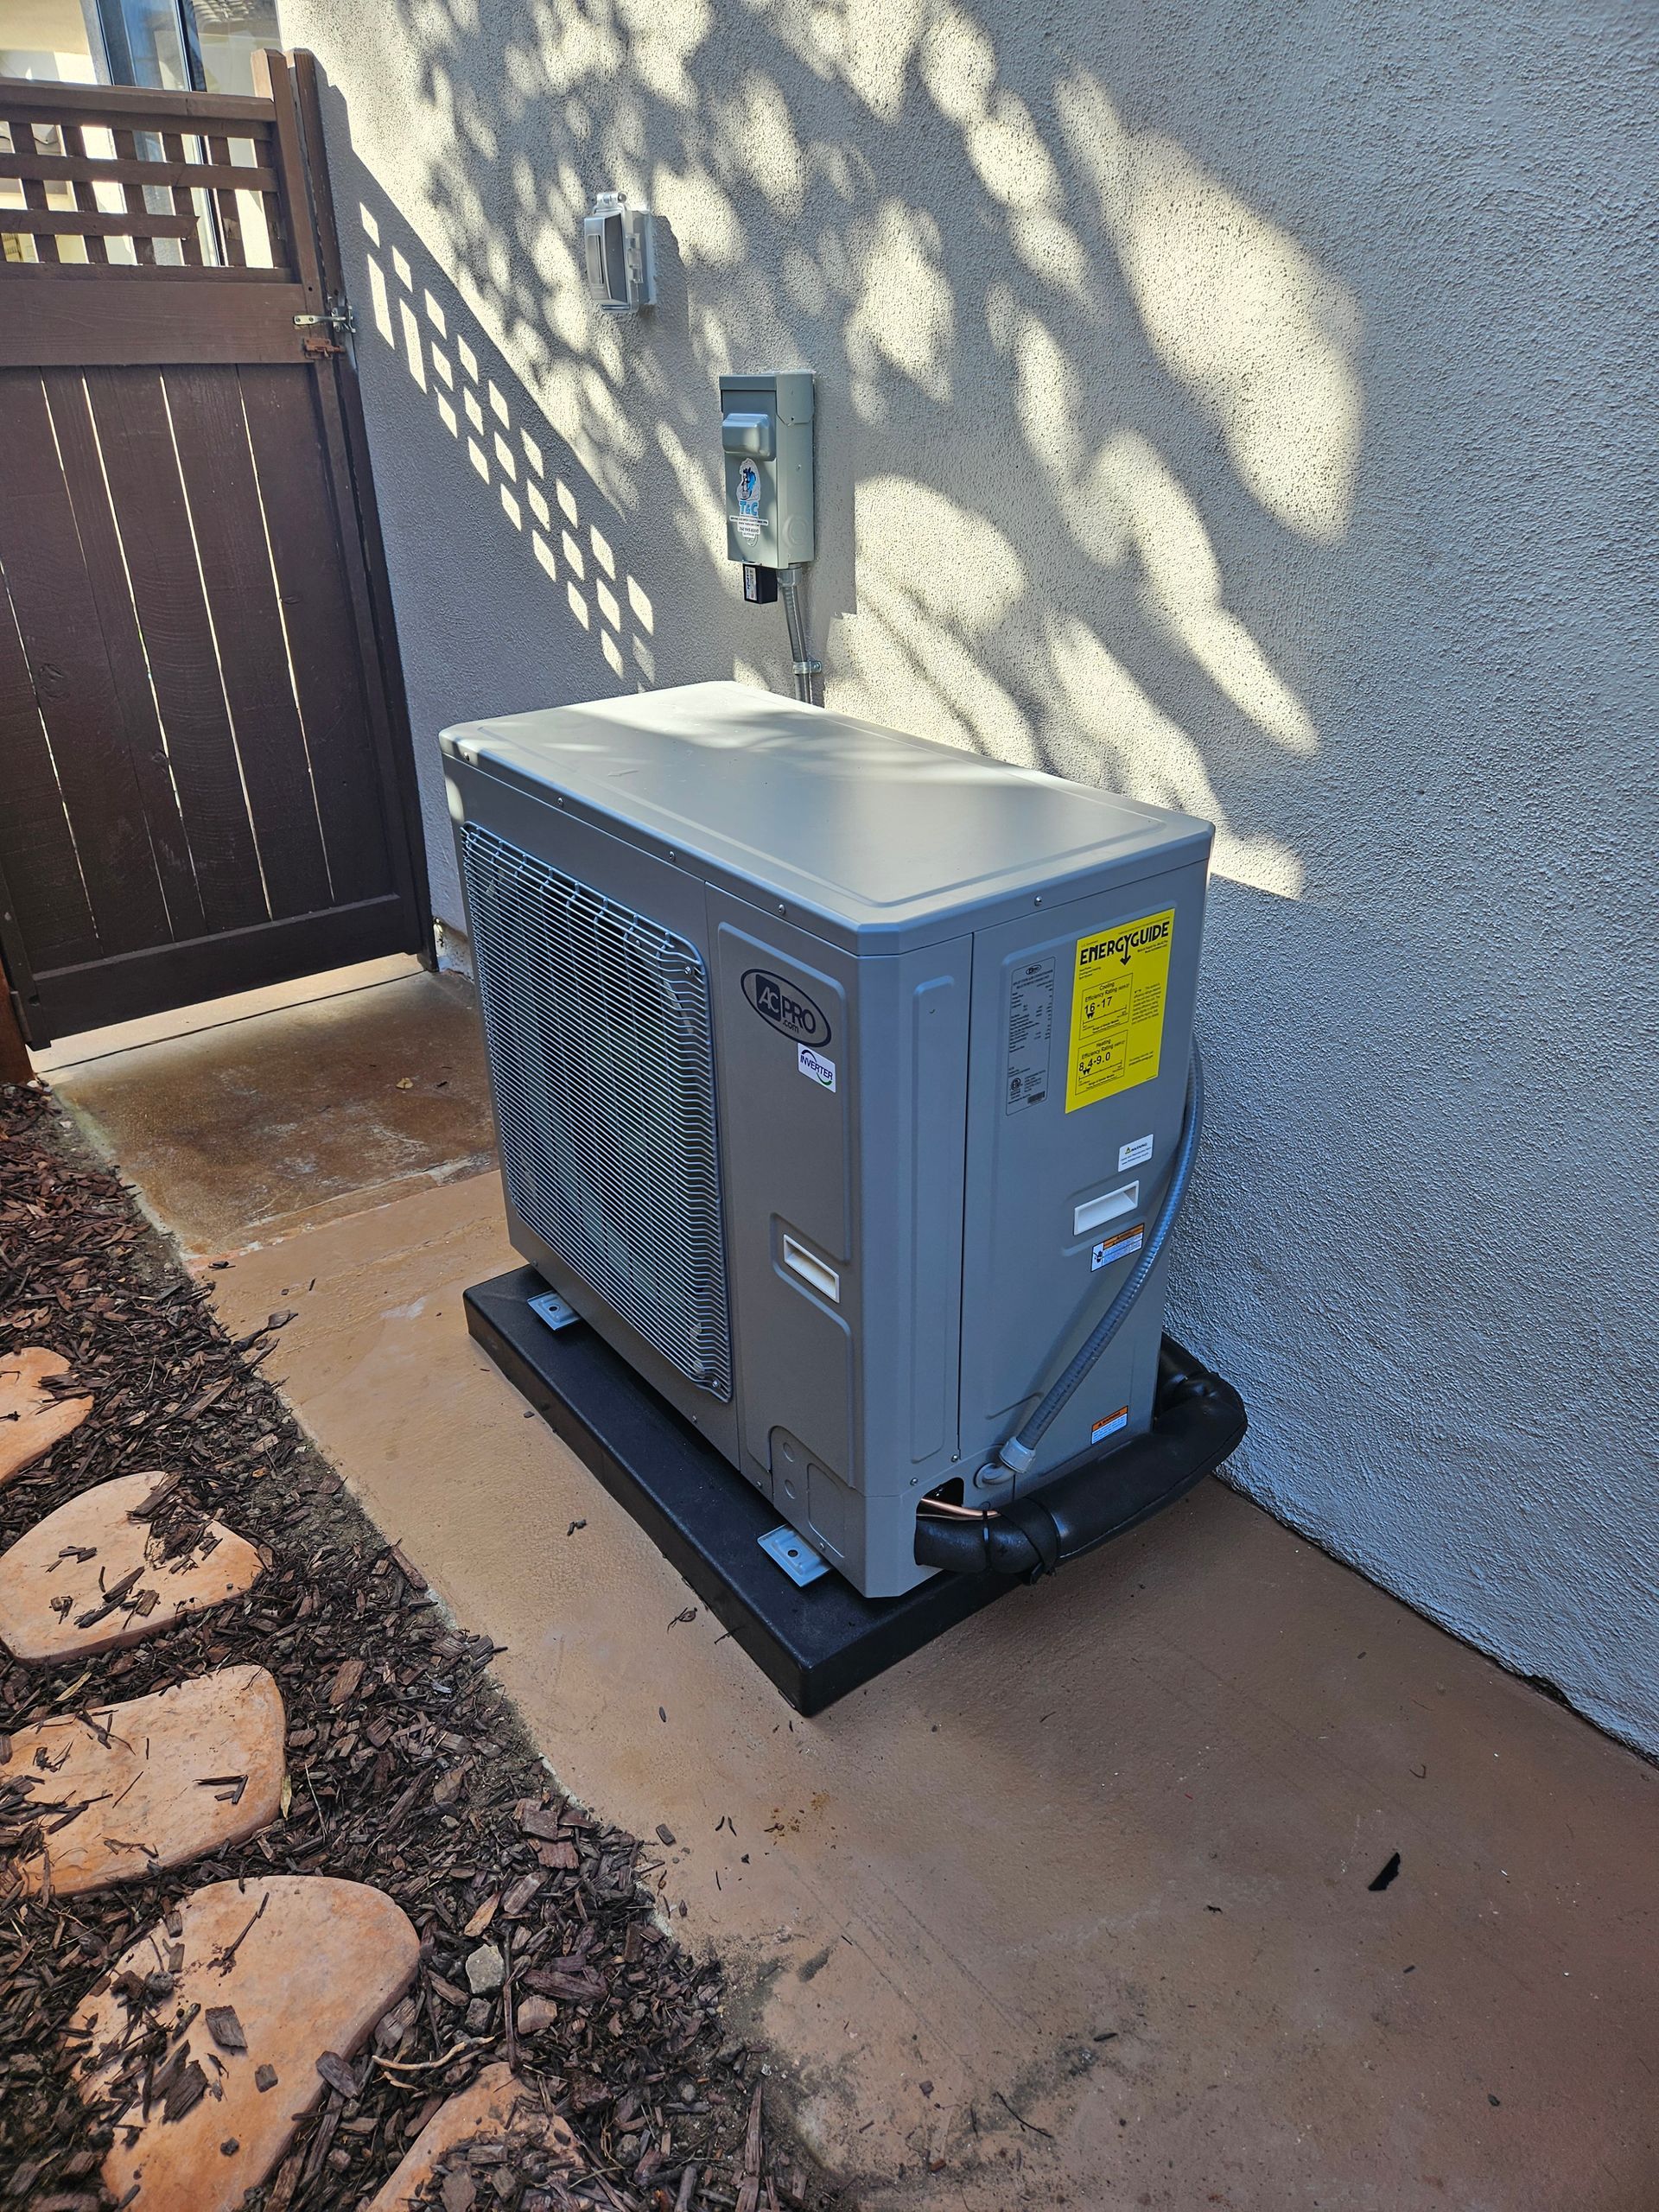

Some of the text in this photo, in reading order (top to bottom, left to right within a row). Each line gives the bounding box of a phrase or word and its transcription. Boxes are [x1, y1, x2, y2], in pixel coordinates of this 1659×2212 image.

[740, 500, 758, 516] T&C
[1079, 920, 1170, 966] ENERGYGUIDE
[759, 986, 817, 1034] AC PRO
[800, 1054, 833, 1080] INVERTER
